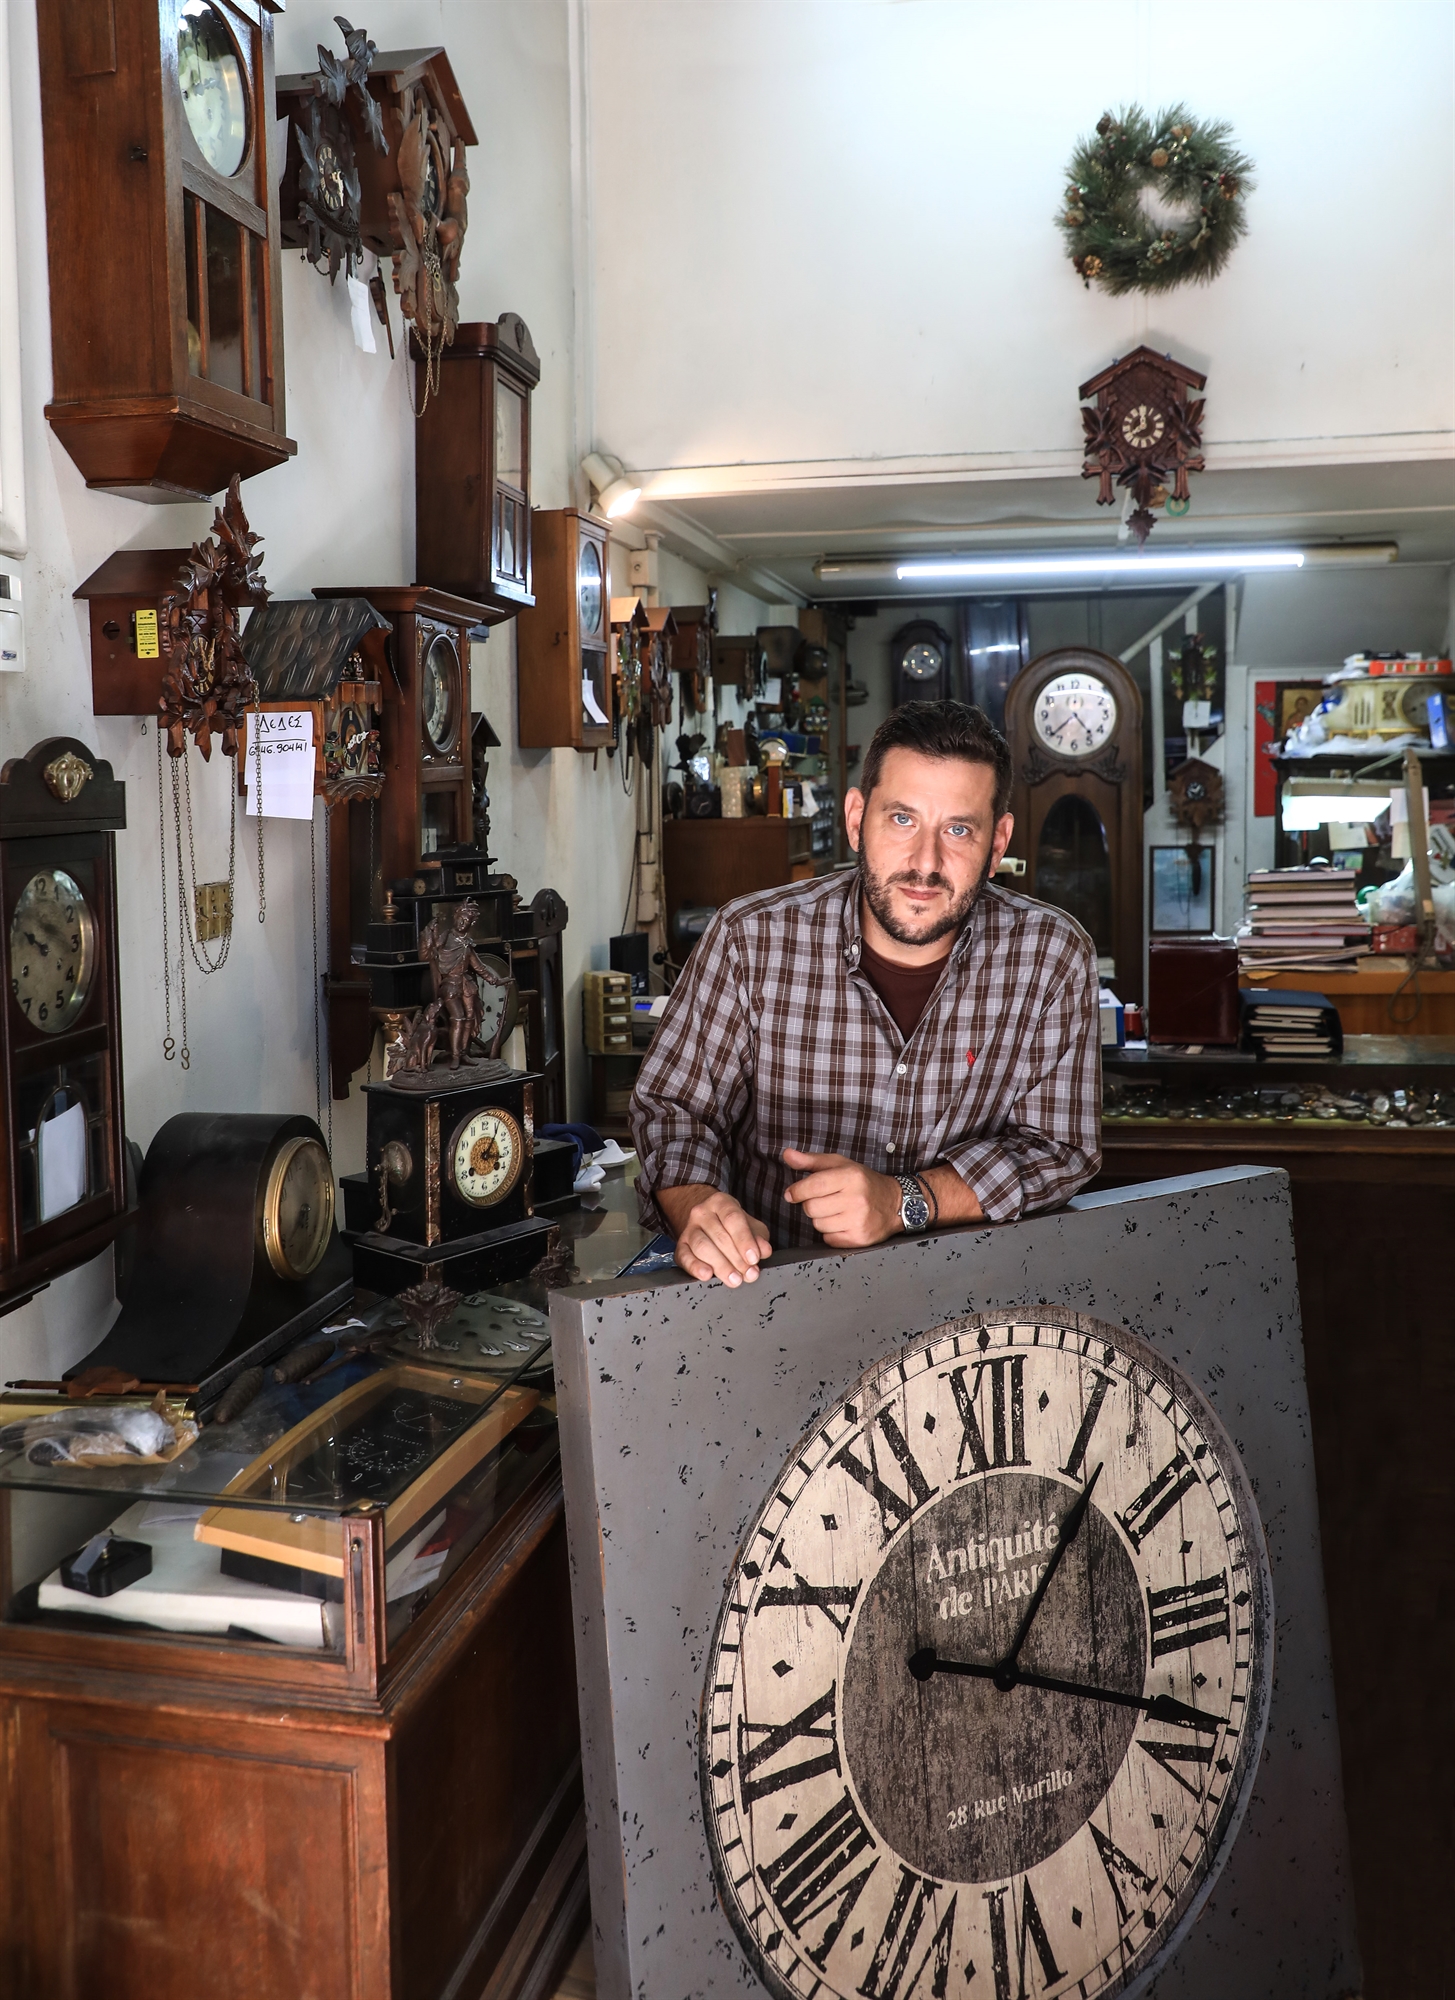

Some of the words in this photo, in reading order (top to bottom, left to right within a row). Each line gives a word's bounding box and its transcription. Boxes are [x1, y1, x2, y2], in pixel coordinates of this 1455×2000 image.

[1071, 679, 1079, 689] 12
[1041, 710, 1049, 721] 9
[1102, 709, 1109, 720] 3
[1096, 724, 1104, 734] 4
[1056, 735, 1063, 745] 7
[1070, 740, 1078, 751] 6
[34, 878, 47, 897] 12
[54, 885, 59, 901] 1
[66, 905, 74, 923] 2
[70, 934, 79, 953] 3
[65, 966, 75, 983] 4
[22, 998, 32, 1018] 7
[55, 990, 64, 1009] 5
[39, 1003, 48, 1021] 6
[481, 1121, 489, 1131] 12
[461, 1140, 469, 1151] 10
[458, 1156, 465, 1166] 9
[501, 1161, 506, 1170] 4
[461, 1170, 468, 1180] 8
[471, 1179, 476, 1190] 7
[481, 1181, 488, 1191] 6
[938, 1354, 1032, 1481] XII
[1058, 1368, 1117, 1484] I
[827, 1399, 940, 1550] XI
[1114, 1446, 1202, 1556] II
[926, 1512, 1061, 1584] Antiquité
[754, 1538, 863, 1642] X
[939, 1586, 974, 1620] de
[1146, 1566, 1231, 1670] III
[737, 1679, 843, 1815] IX
[947, 1805, 968, 1831] 28
[974, 1795, 1007, 1819] Rue
[1012, 1769, 1073, 1806] Murillo
[756, 1785, 881, 1974] VIII
[1087, 1820, 1159, 1928] V
